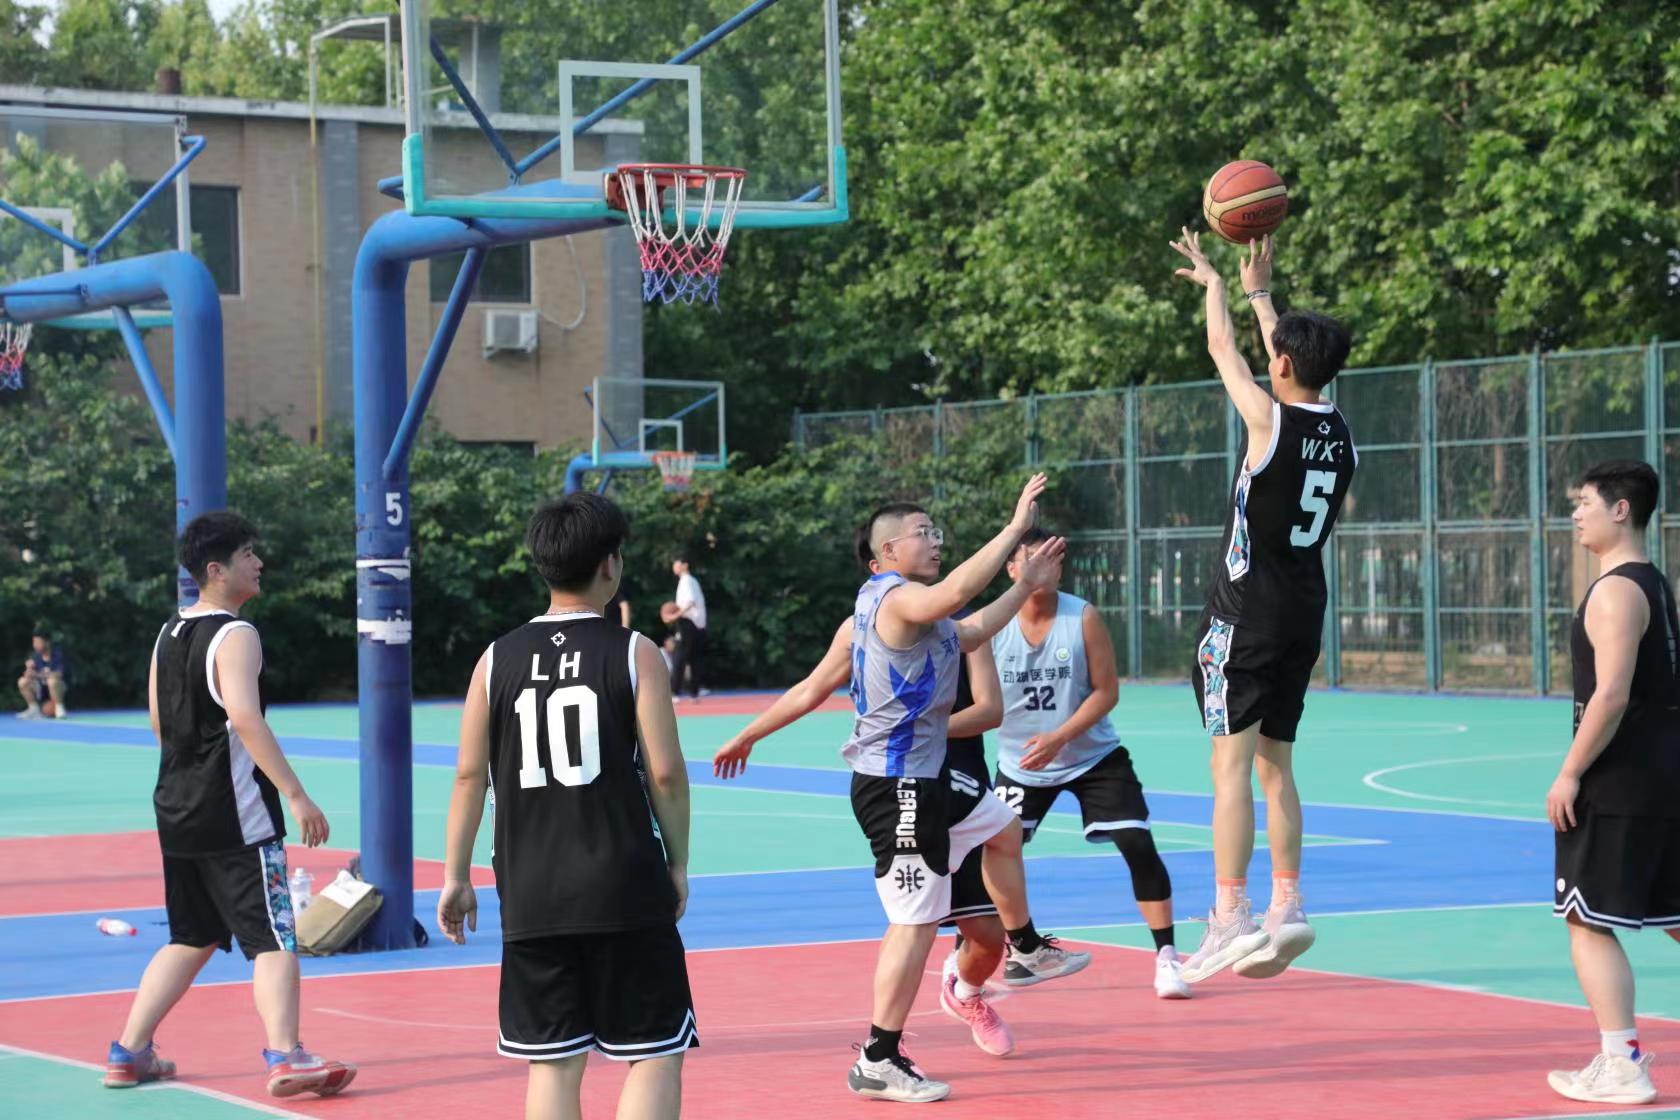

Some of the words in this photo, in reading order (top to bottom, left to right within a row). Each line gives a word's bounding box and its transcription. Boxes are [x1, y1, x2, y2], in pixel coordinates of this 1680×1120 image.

[385, 492, 403, 526] 5
[1289, 469, 1337, 548] 5
[1023, 685, 1056, 711] 32
[514, 685, 601, 789] 10
